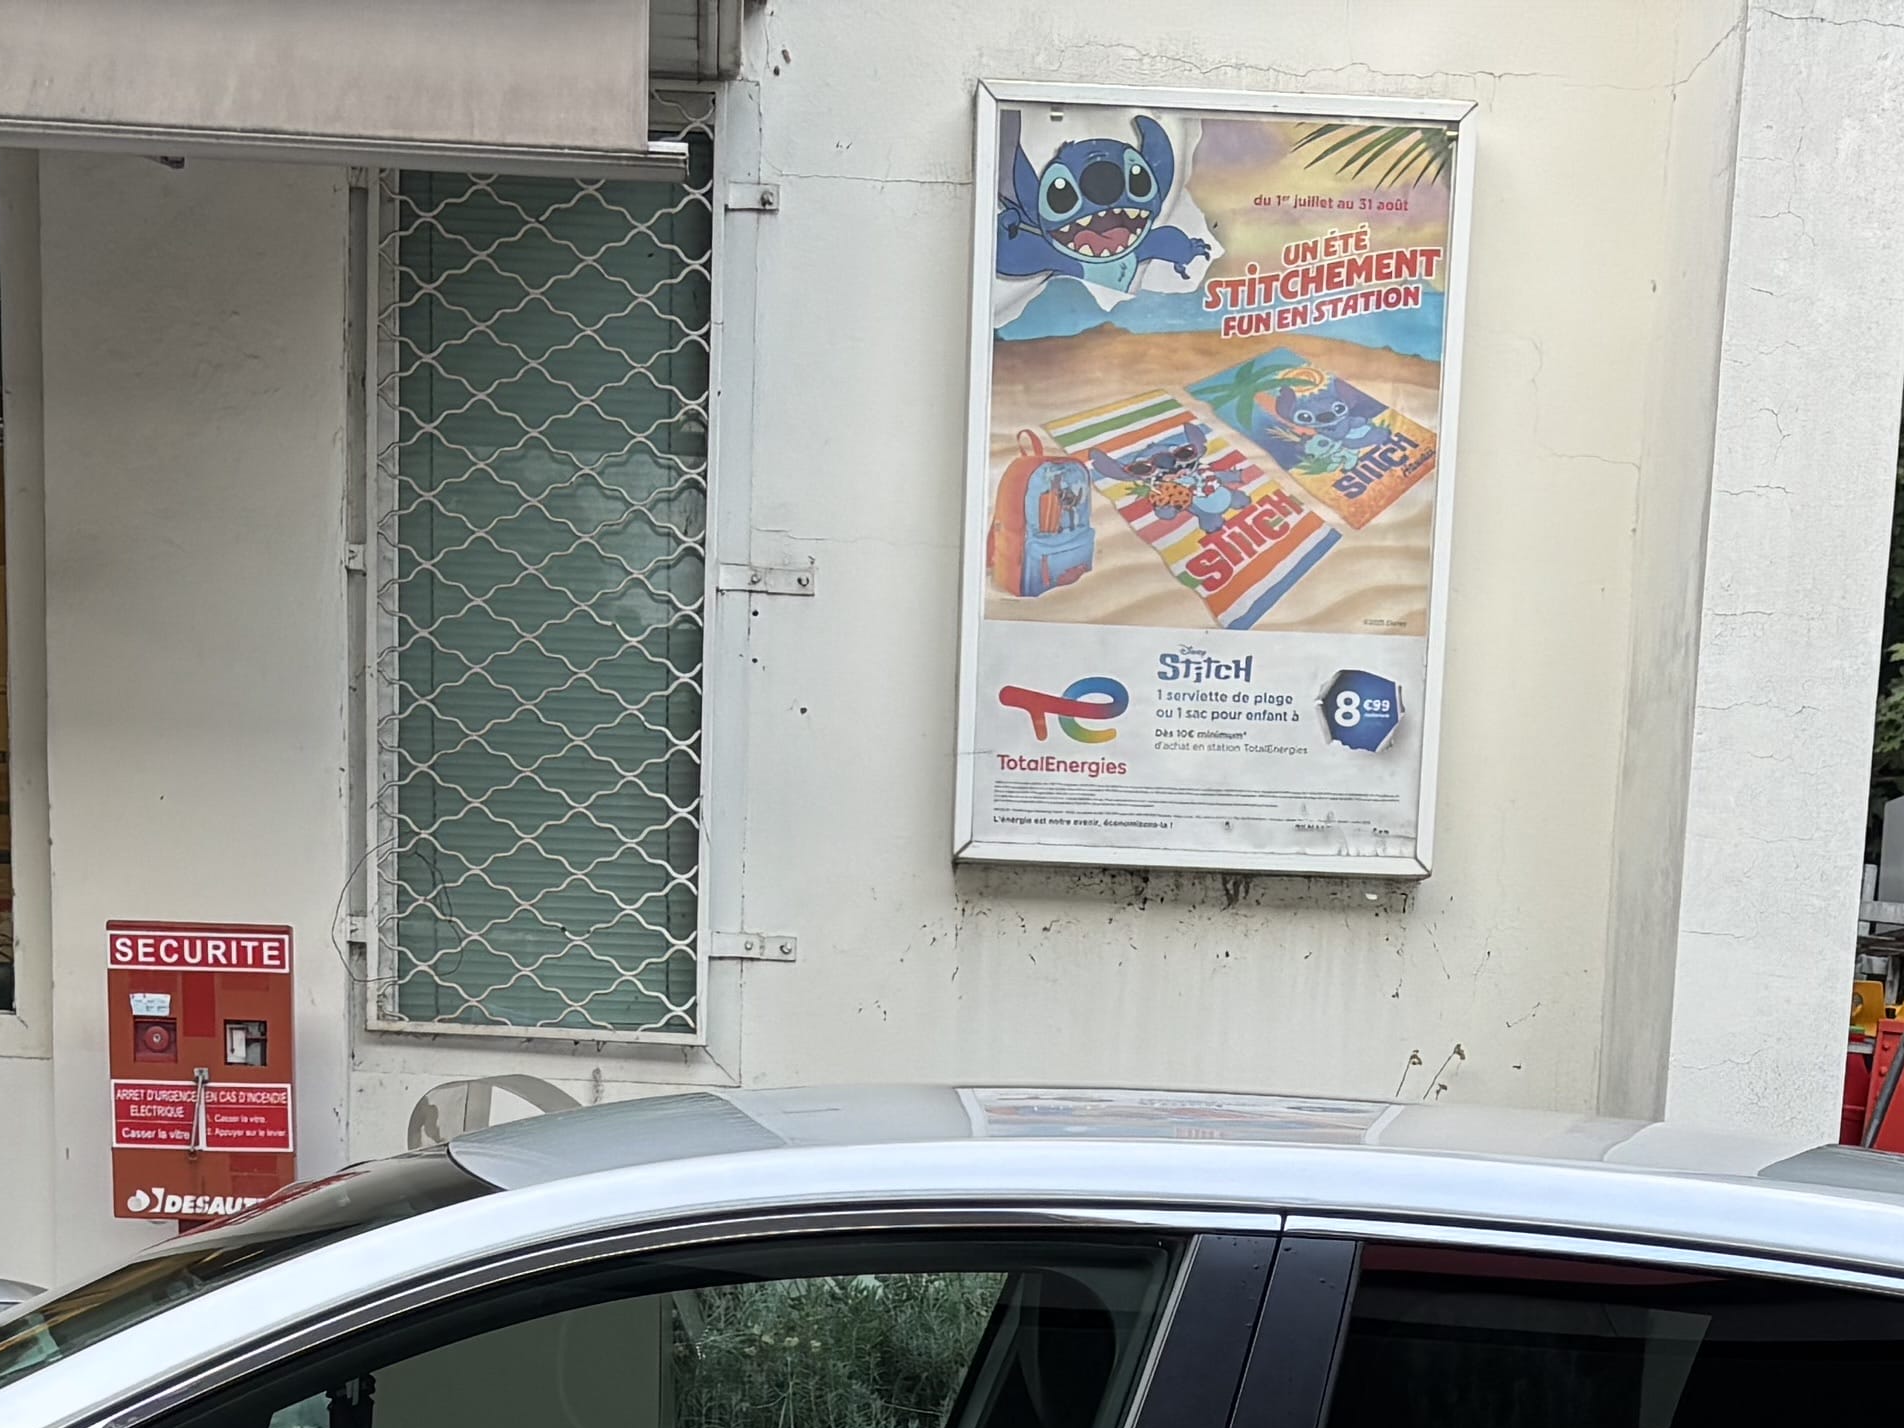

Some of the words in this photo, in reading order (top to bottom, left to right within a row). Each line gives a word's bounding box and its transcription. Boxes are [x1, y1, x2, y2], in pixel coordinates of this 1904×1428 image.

[1254, 195, 1271, 206] du
[1294, 195, 1333, 209] juillet
[1337, 199, 1354, 210] au
[1359, 198, 1372, 210] 31
[1377, 198, 1409, 211] août
[1284, 239, 1318, 266] UN
[1325, 223, 1368, 258] ÉTÉ
[1223, 311, 1272, 337] FUN
[1277, 304, 1309, 329] EN
[1313, 287, 1420, 323] STATION
[1167, 689, 1228, 703] serviette
[1232, 691, 1249, 703] de
[1254, 692, 1293, 706] plage
[1156, 711, 1173, 719] ou
[1186, 711, 1207, 720] sac
[1211, 711, 1242, 722] pour
[1246, 708, 1288, 722] enfant
[1334, 691, 1360, 727] 8
[1207, 742, 1241, 753] station
[1244, 743, 1308, 756] TotalEnergies
[997, 754, 1127, 778] TotalEnergies
[115, 938, 281, 966] SECURITE
[116, 1089, 144, 1101] ARRET
[146, 1089, 197, 1103] D'URGENCE
[204, 1091, 217, 1102] EN
[219, 1091, 236, 1103] CAS
[238, 1092, 287, 1104] D'INCENDIE
[130, 1105, 185, 1118] ELECTRIQUE
[122, 1127, 154, 1139] Casser
[158, 1128, 168, 1139] la
[170, 1128, 190, 1139] vitre
